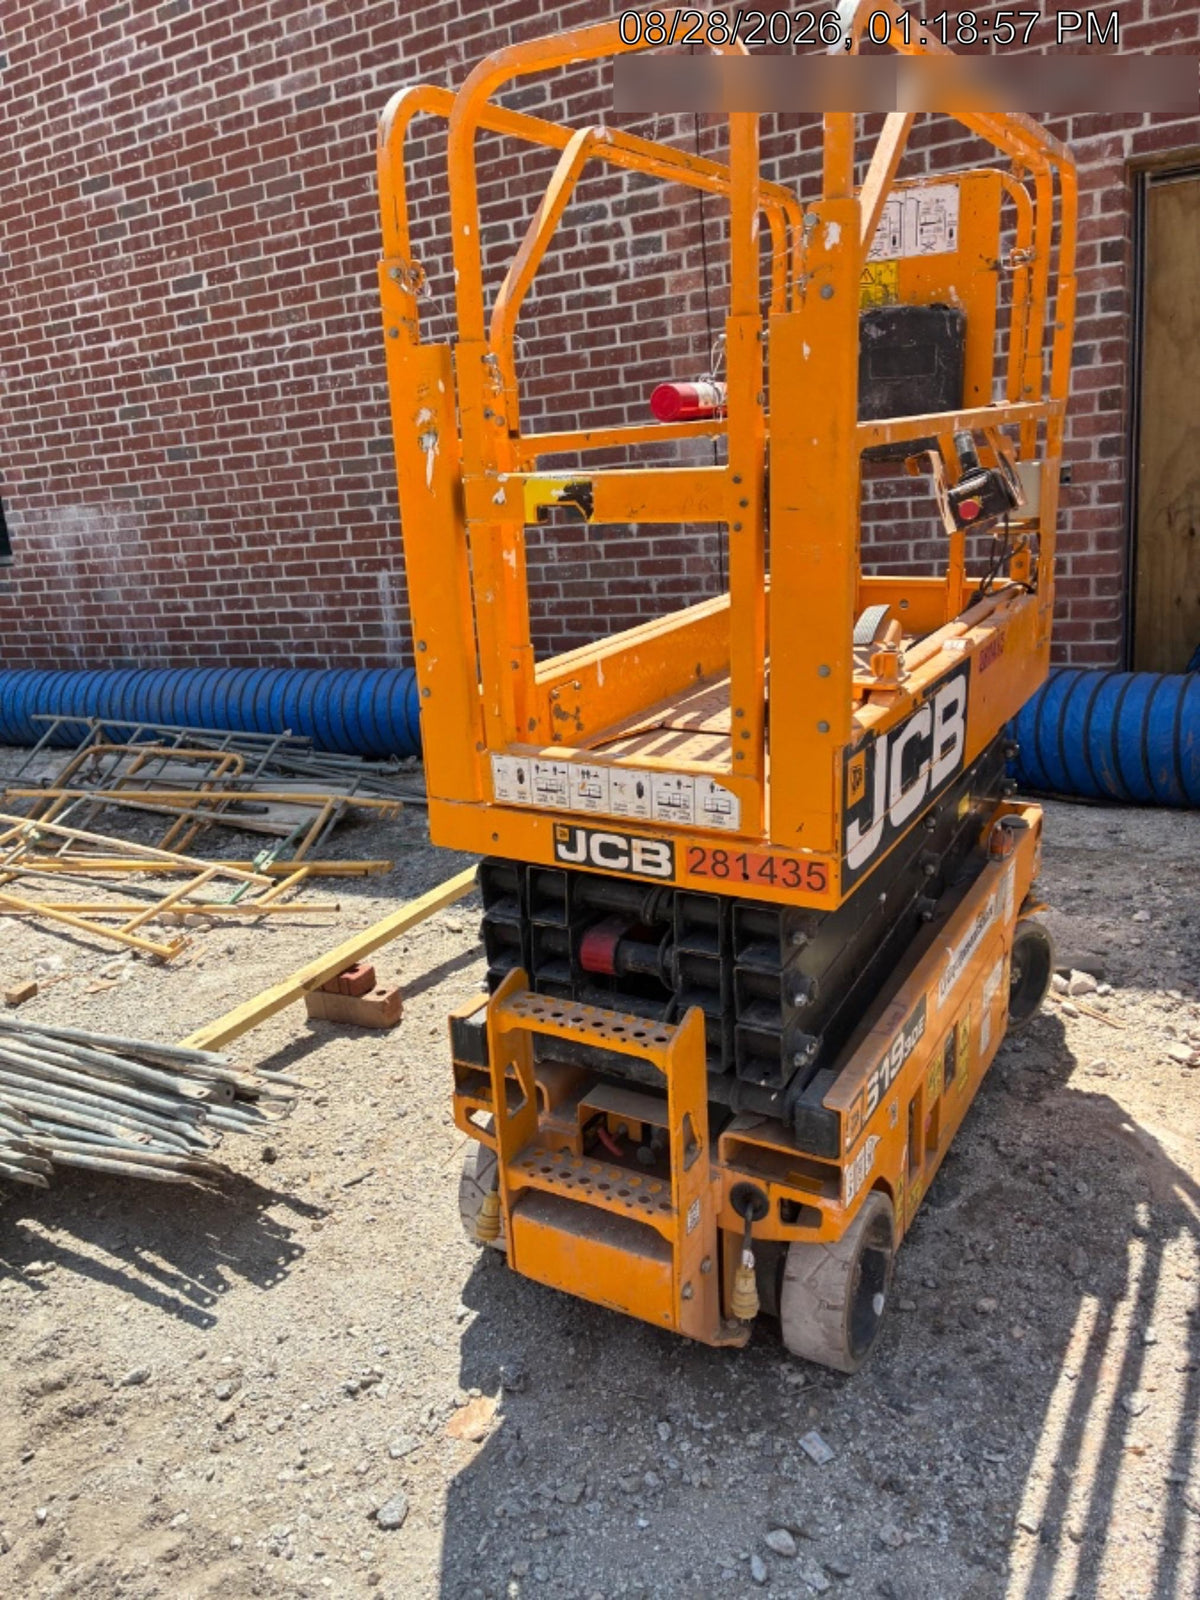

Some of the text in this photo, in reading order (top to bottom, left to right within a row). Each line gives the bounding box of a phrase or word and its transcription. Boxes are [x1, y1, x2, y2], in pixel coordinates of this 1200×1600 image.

[846, 674, 966, 871] JCB
[556, 829, 673, 878] JCB
[688, 846, 827, 892] 281435
